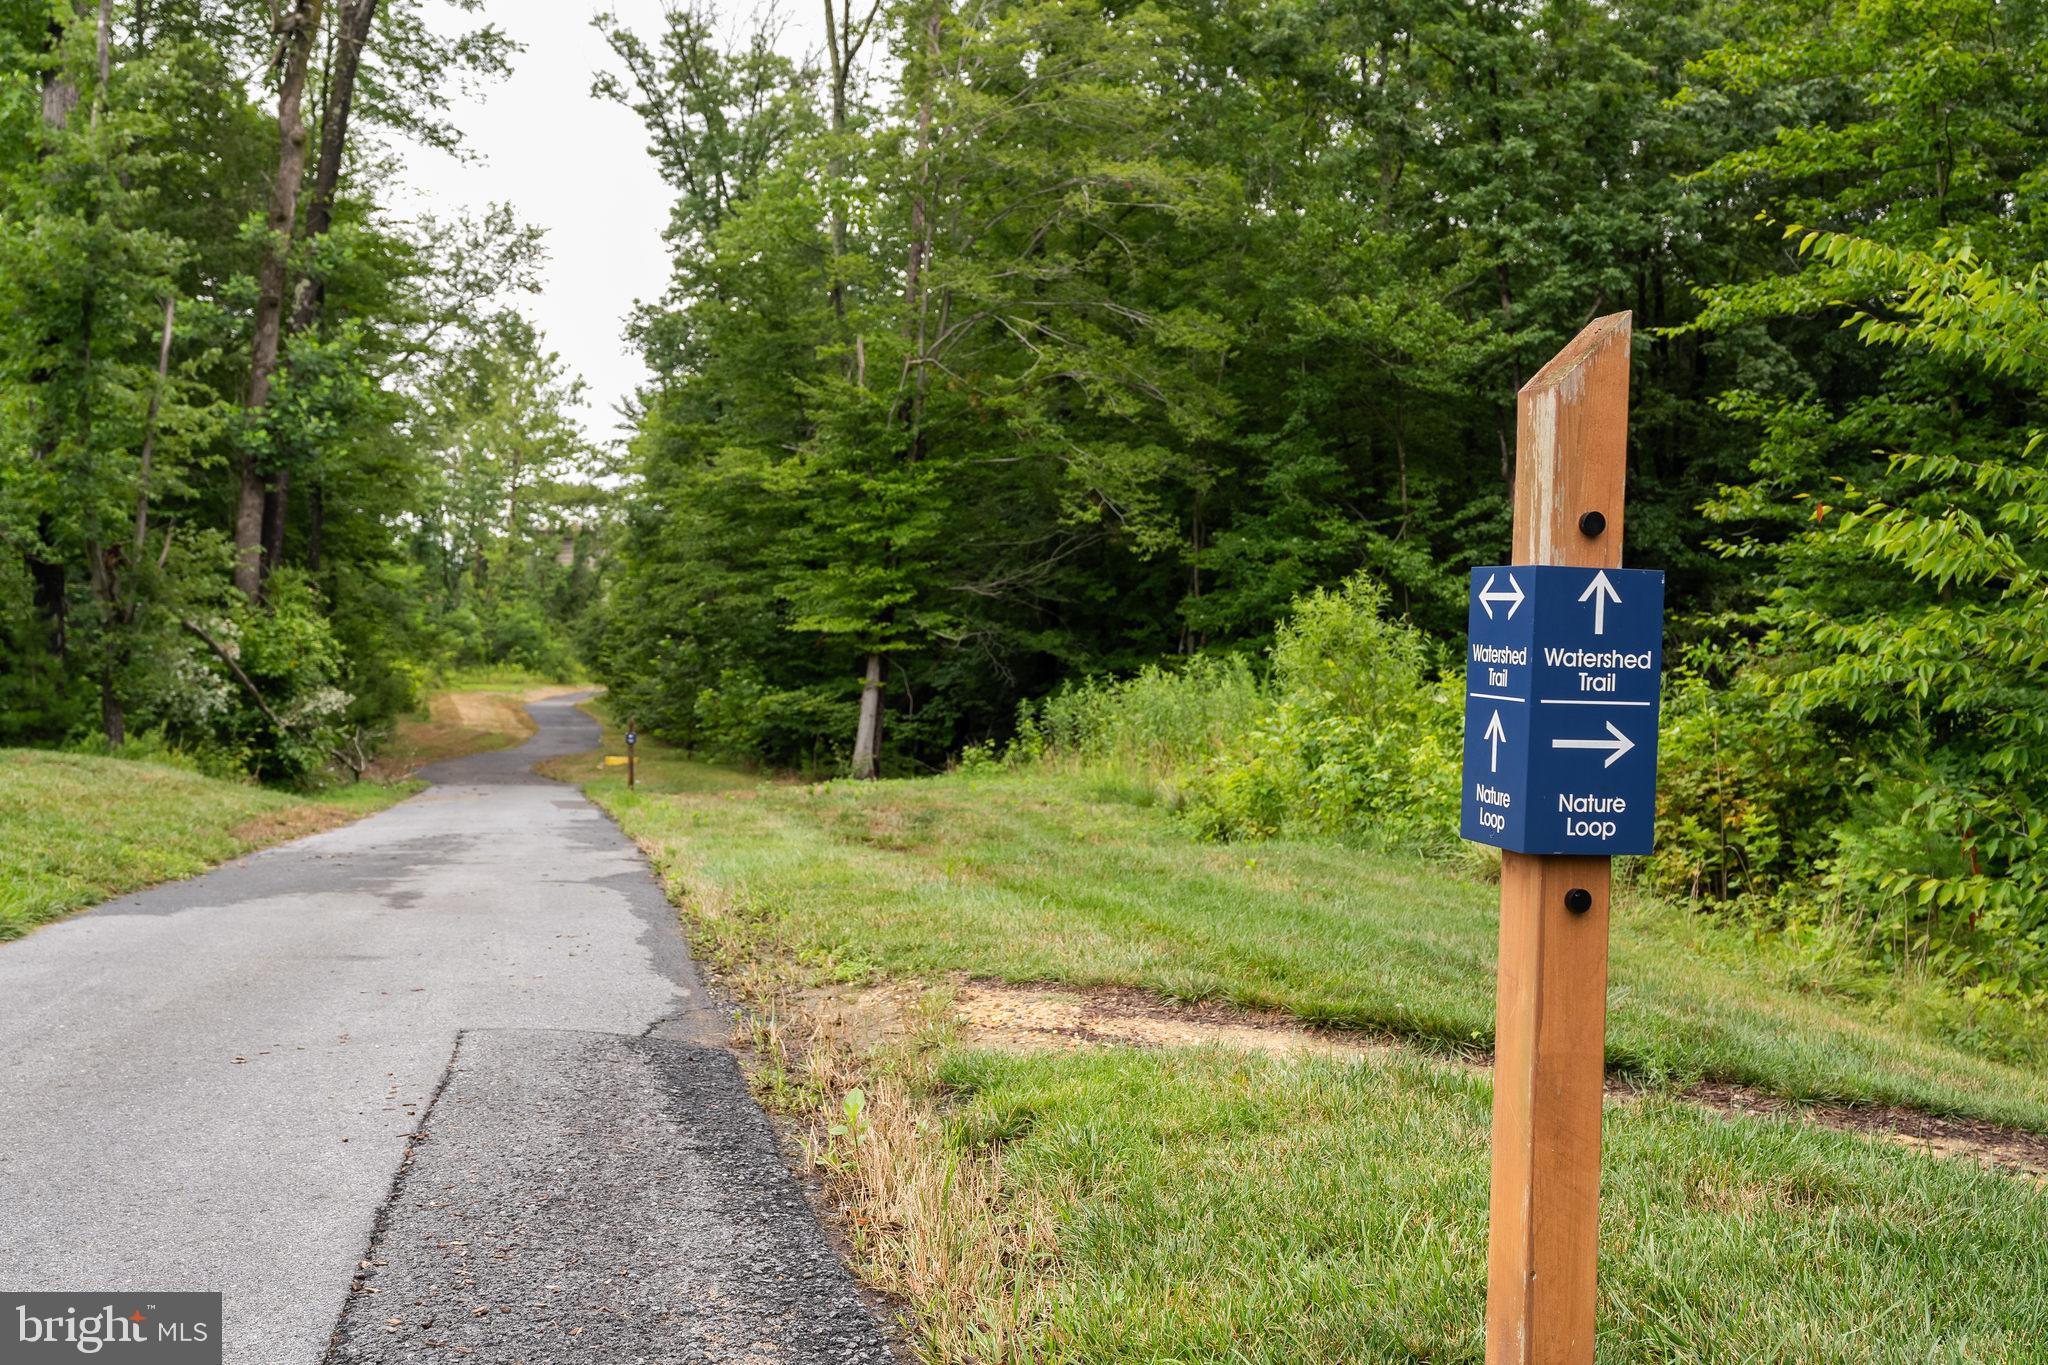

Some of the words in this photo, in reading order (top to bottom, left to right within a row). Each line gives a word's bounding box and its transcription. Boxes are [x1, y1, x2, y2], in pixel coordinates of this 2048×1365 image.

[1472, 643, 1527, 666] Watershed
[1544, 647, 1652, 670] Watershed
[1488, 667, 1508, 688] Trail
[1578, 672, 1616, 692] Trail
[1476, 783, 1511, 808] Nature
[1558, 793, 1626, 813] Nature
[1479, 807, 1505, 833] Loop
[1566, 817, 1616, 840] Loop
